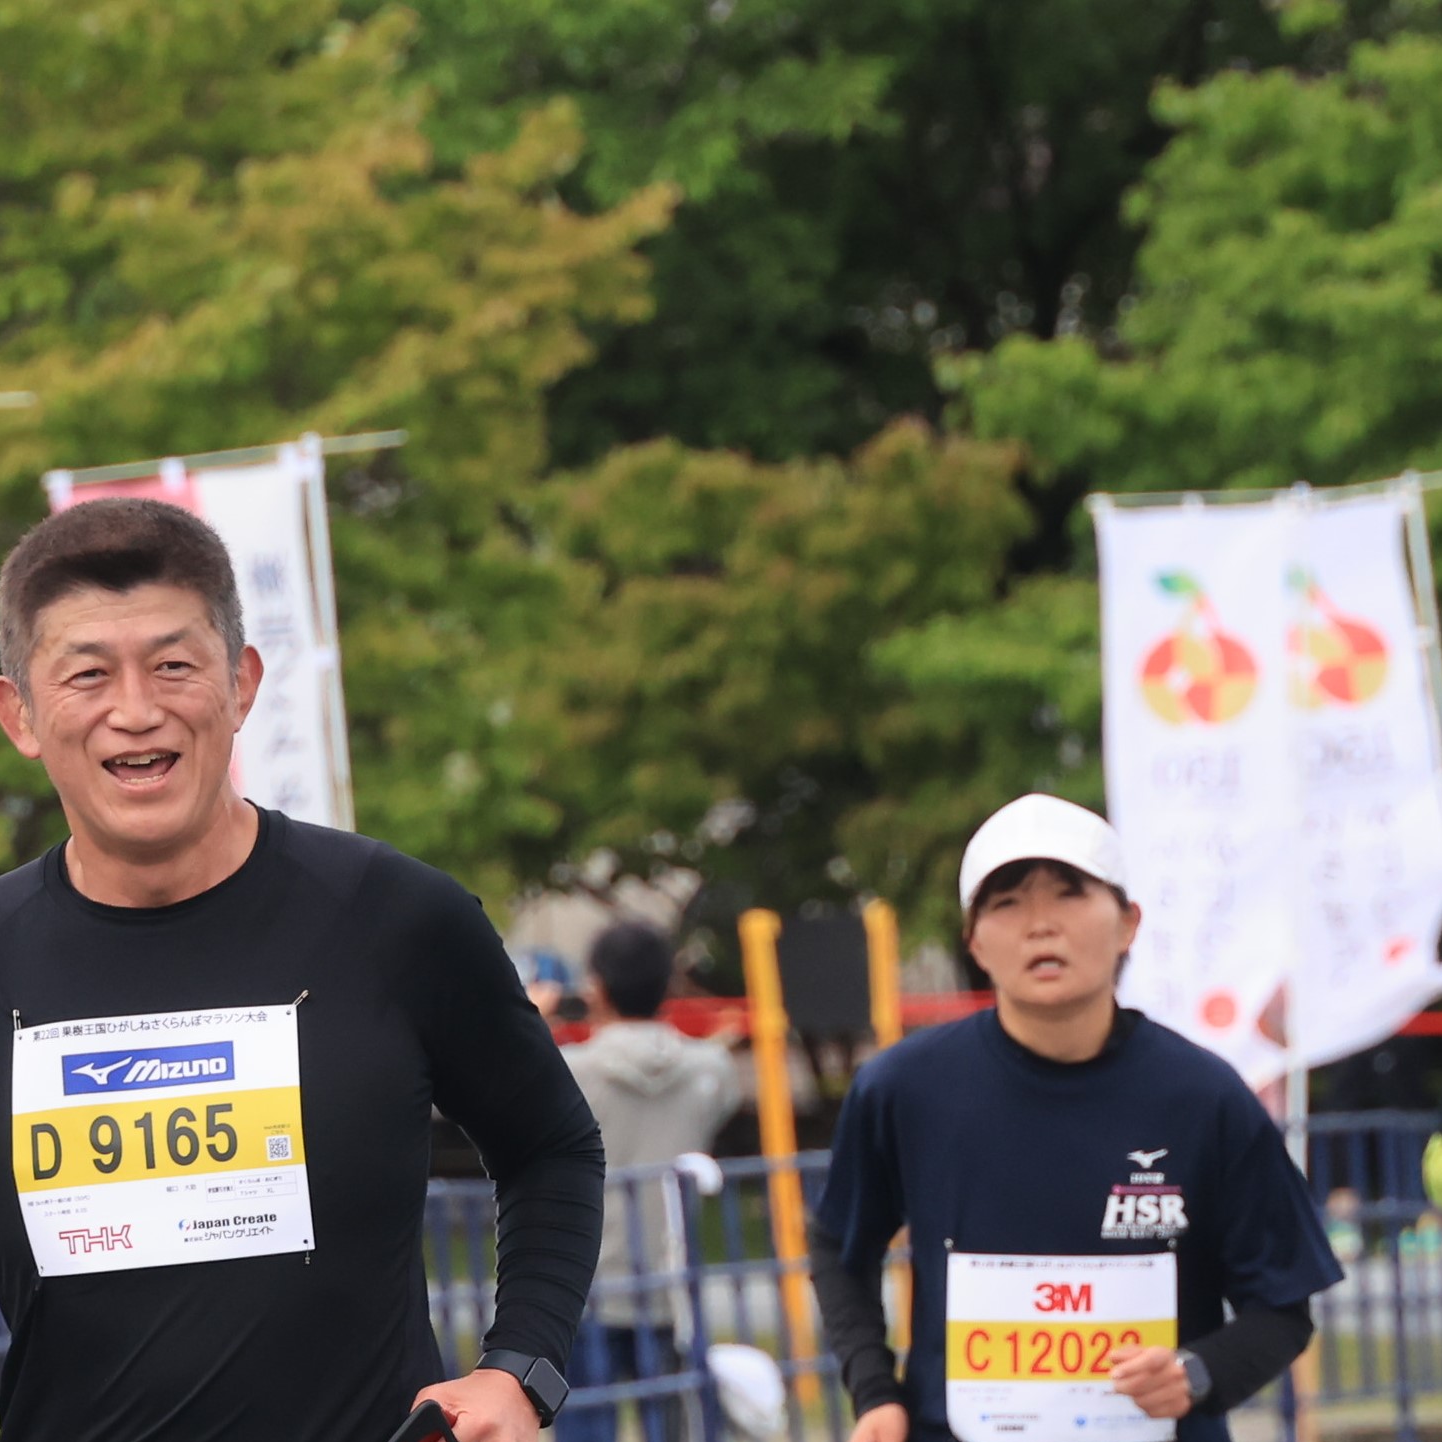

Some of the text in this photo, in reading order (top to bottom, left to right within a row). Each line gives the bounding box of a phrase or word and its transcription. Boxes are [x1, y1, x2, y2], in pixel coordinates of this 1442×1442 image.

[62, 1011, 268, 1037] 果樹王国ひがしねさくらんぼマラソン大会
[31, 1103, 238, 1180] D 9165
[233, 1213, 278, 1226] Create
[1101, 1193, 1190, 1230] HSR
[59, 1224, 133, 1255] THK
[1034, 1282, 1093, 1313] 3M
[966, 1329, 1141, 1374] C1202
